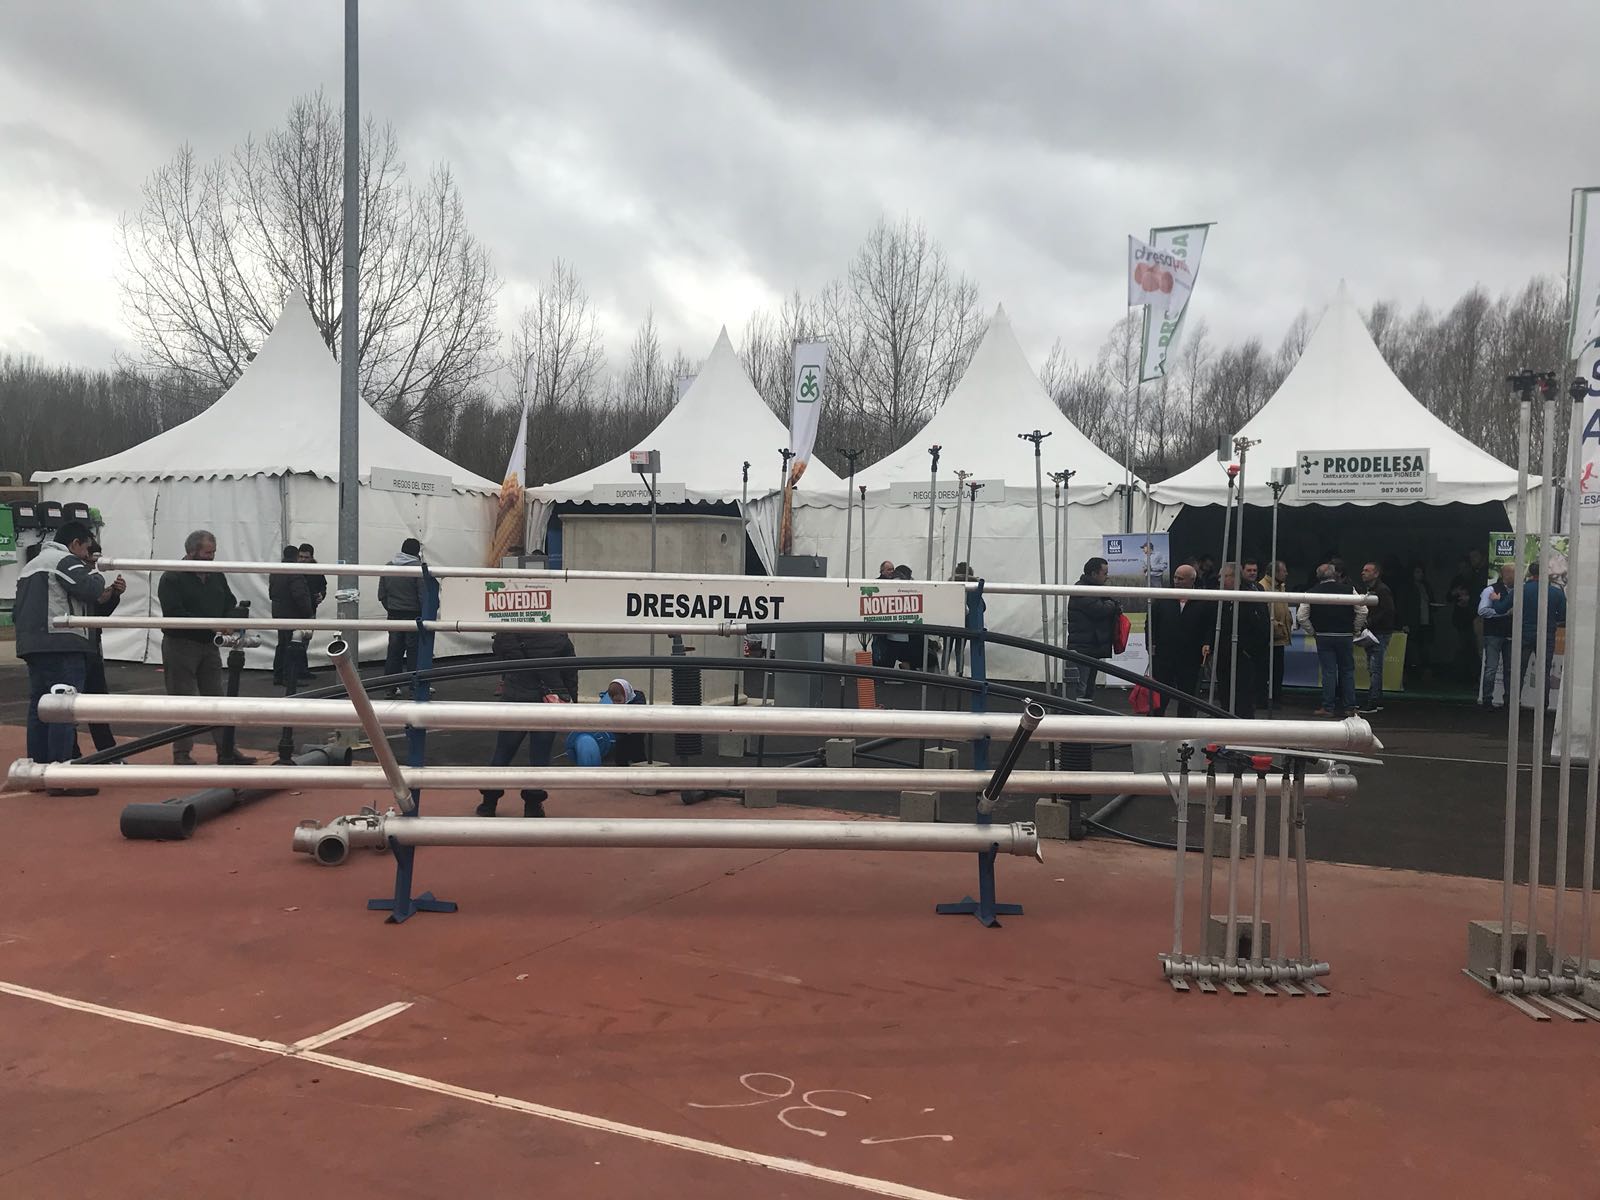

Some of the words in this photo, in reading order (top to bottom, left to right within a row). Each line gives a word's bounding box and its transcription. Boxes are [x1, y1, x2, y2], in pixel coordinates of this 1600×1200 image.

[1323, 456, 1424, 473] PRODELESA
[411, 481, 421, 490] DEL
[1301, 487, 1356, 495] www.prodelesa.com
[489, 591, 547, 611] NOVEDAD
[626, 592, 785, 620] DRESAPLAST
[863, 595, 920, 615] NOVEDAD
